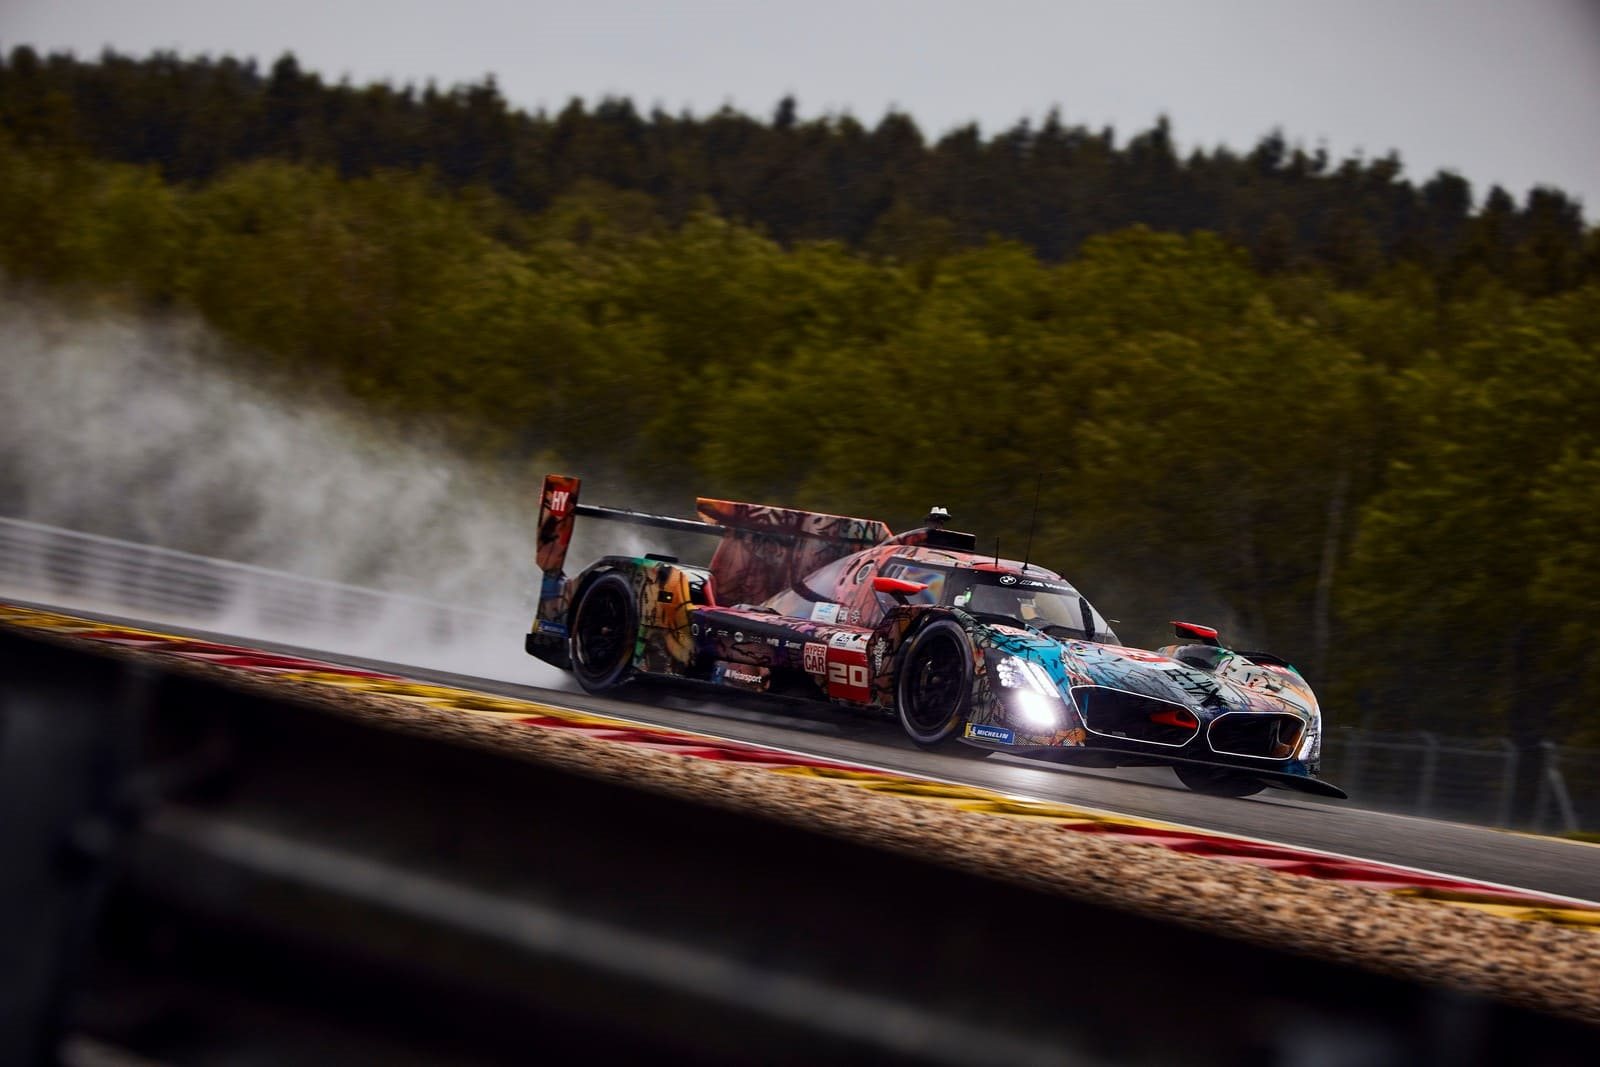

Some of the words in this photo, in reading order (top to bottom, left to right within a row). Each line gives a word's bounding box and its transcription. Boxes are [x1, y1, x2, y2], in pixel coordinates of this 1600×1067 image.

[551, 490, 569, 512] HY
[806, 644, 826, 656] HYPER
[805, 655, 826, 673] CAR
[828, 662, 869, 688] 20
[976, 729, 1009, 739] MICHELIN
